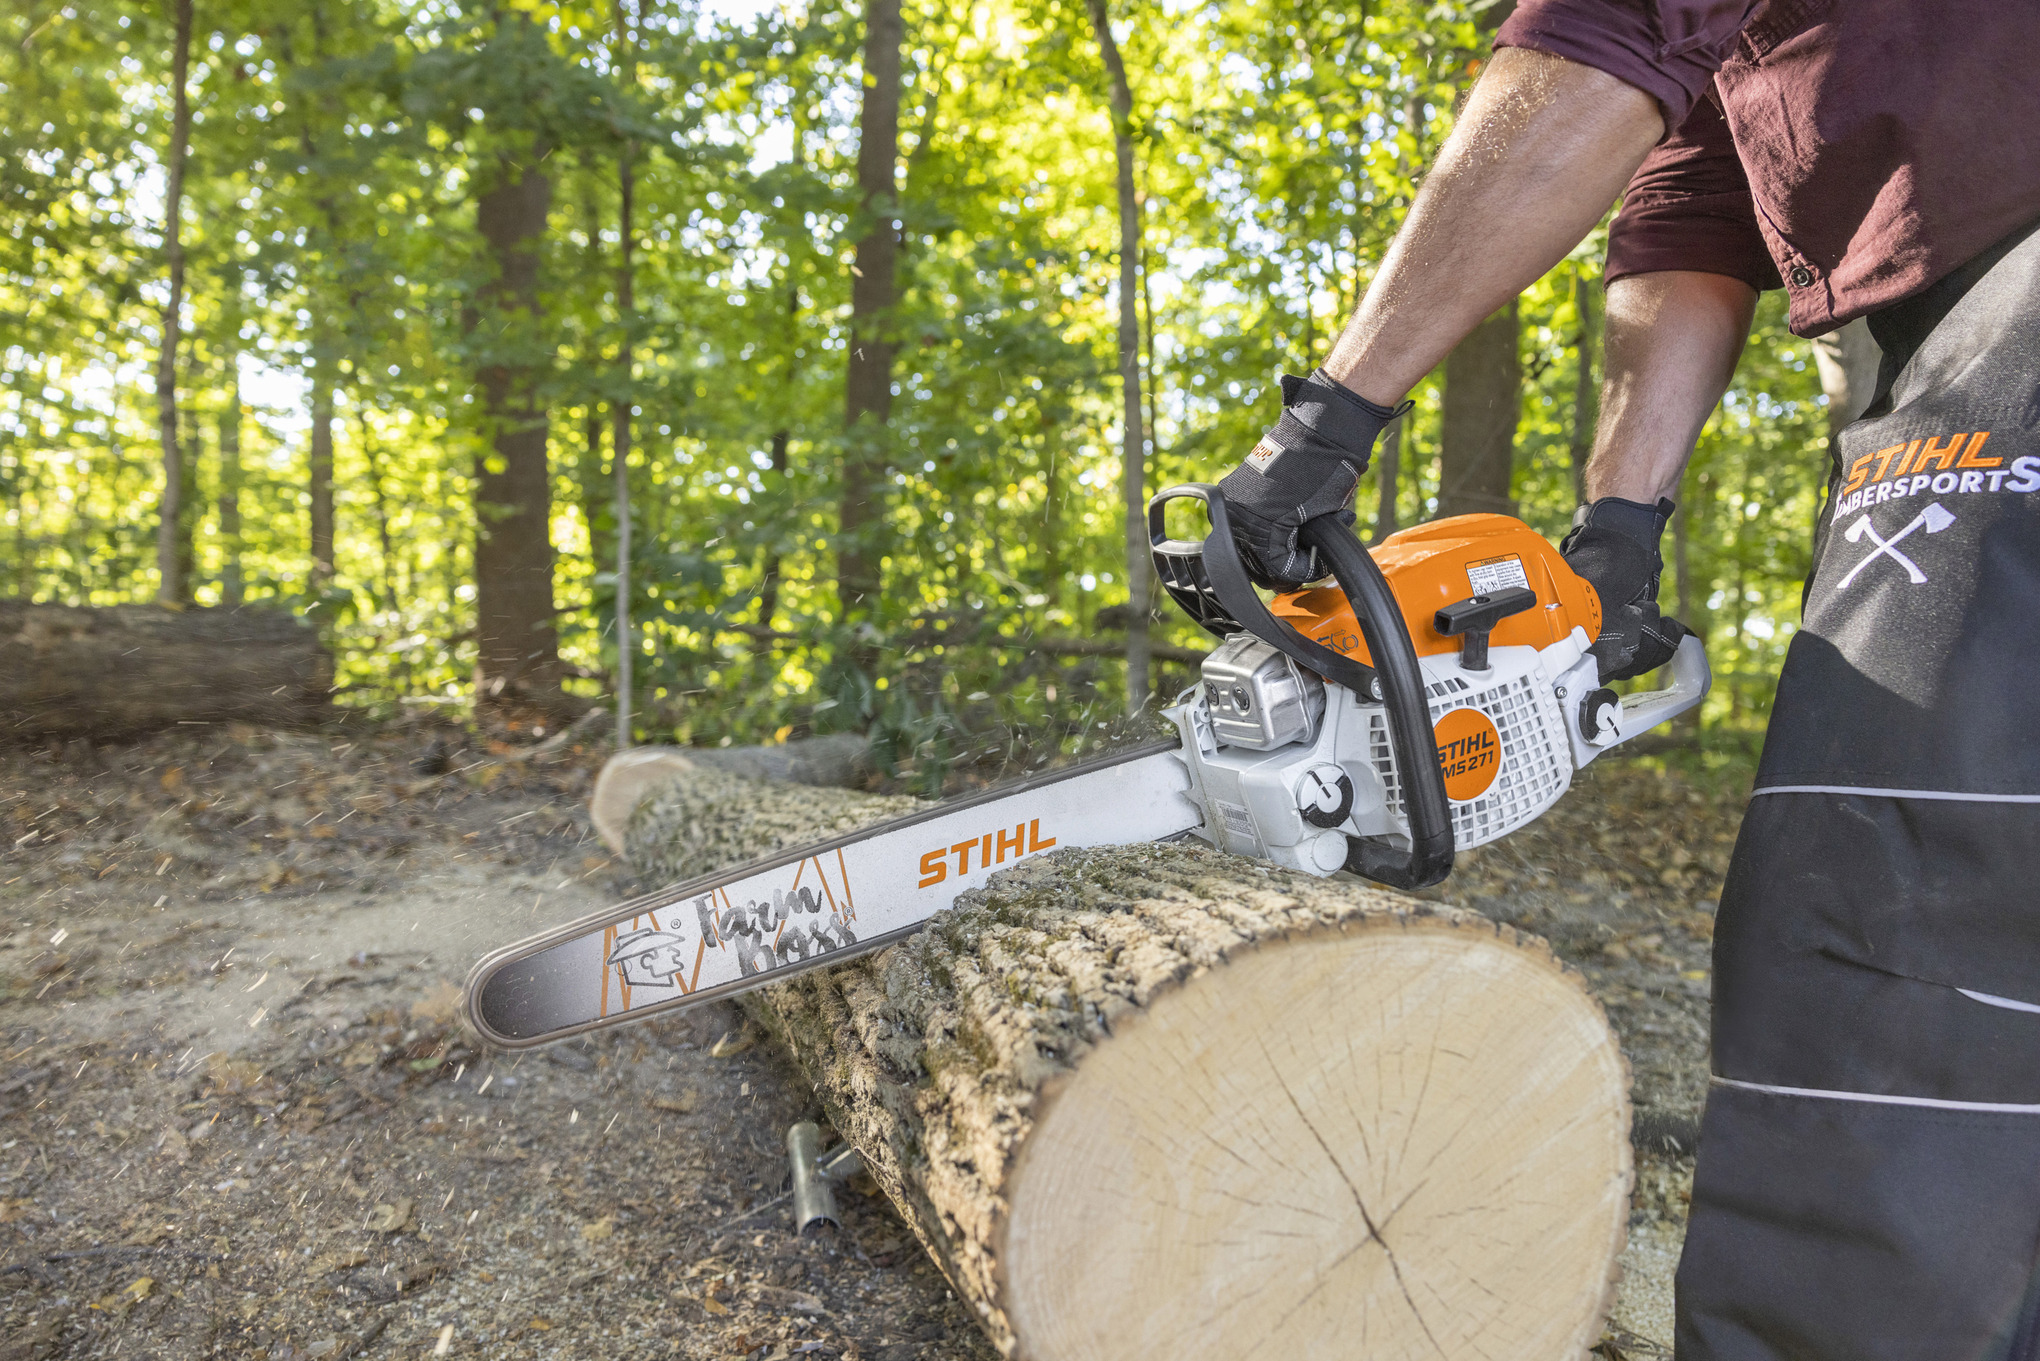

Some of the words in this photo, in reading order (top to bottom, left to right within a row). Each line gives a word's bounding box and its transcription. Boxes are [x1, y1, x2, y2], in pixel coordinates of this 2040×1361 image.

[1843, 431, 2003, 495] STIHL
[1438, 731, 1494, 763] STIHL
[918, 818, 1056, 889] STIHL
[692, 886, 822, 948] Farm
[734, 912, 858, 978] Boss
